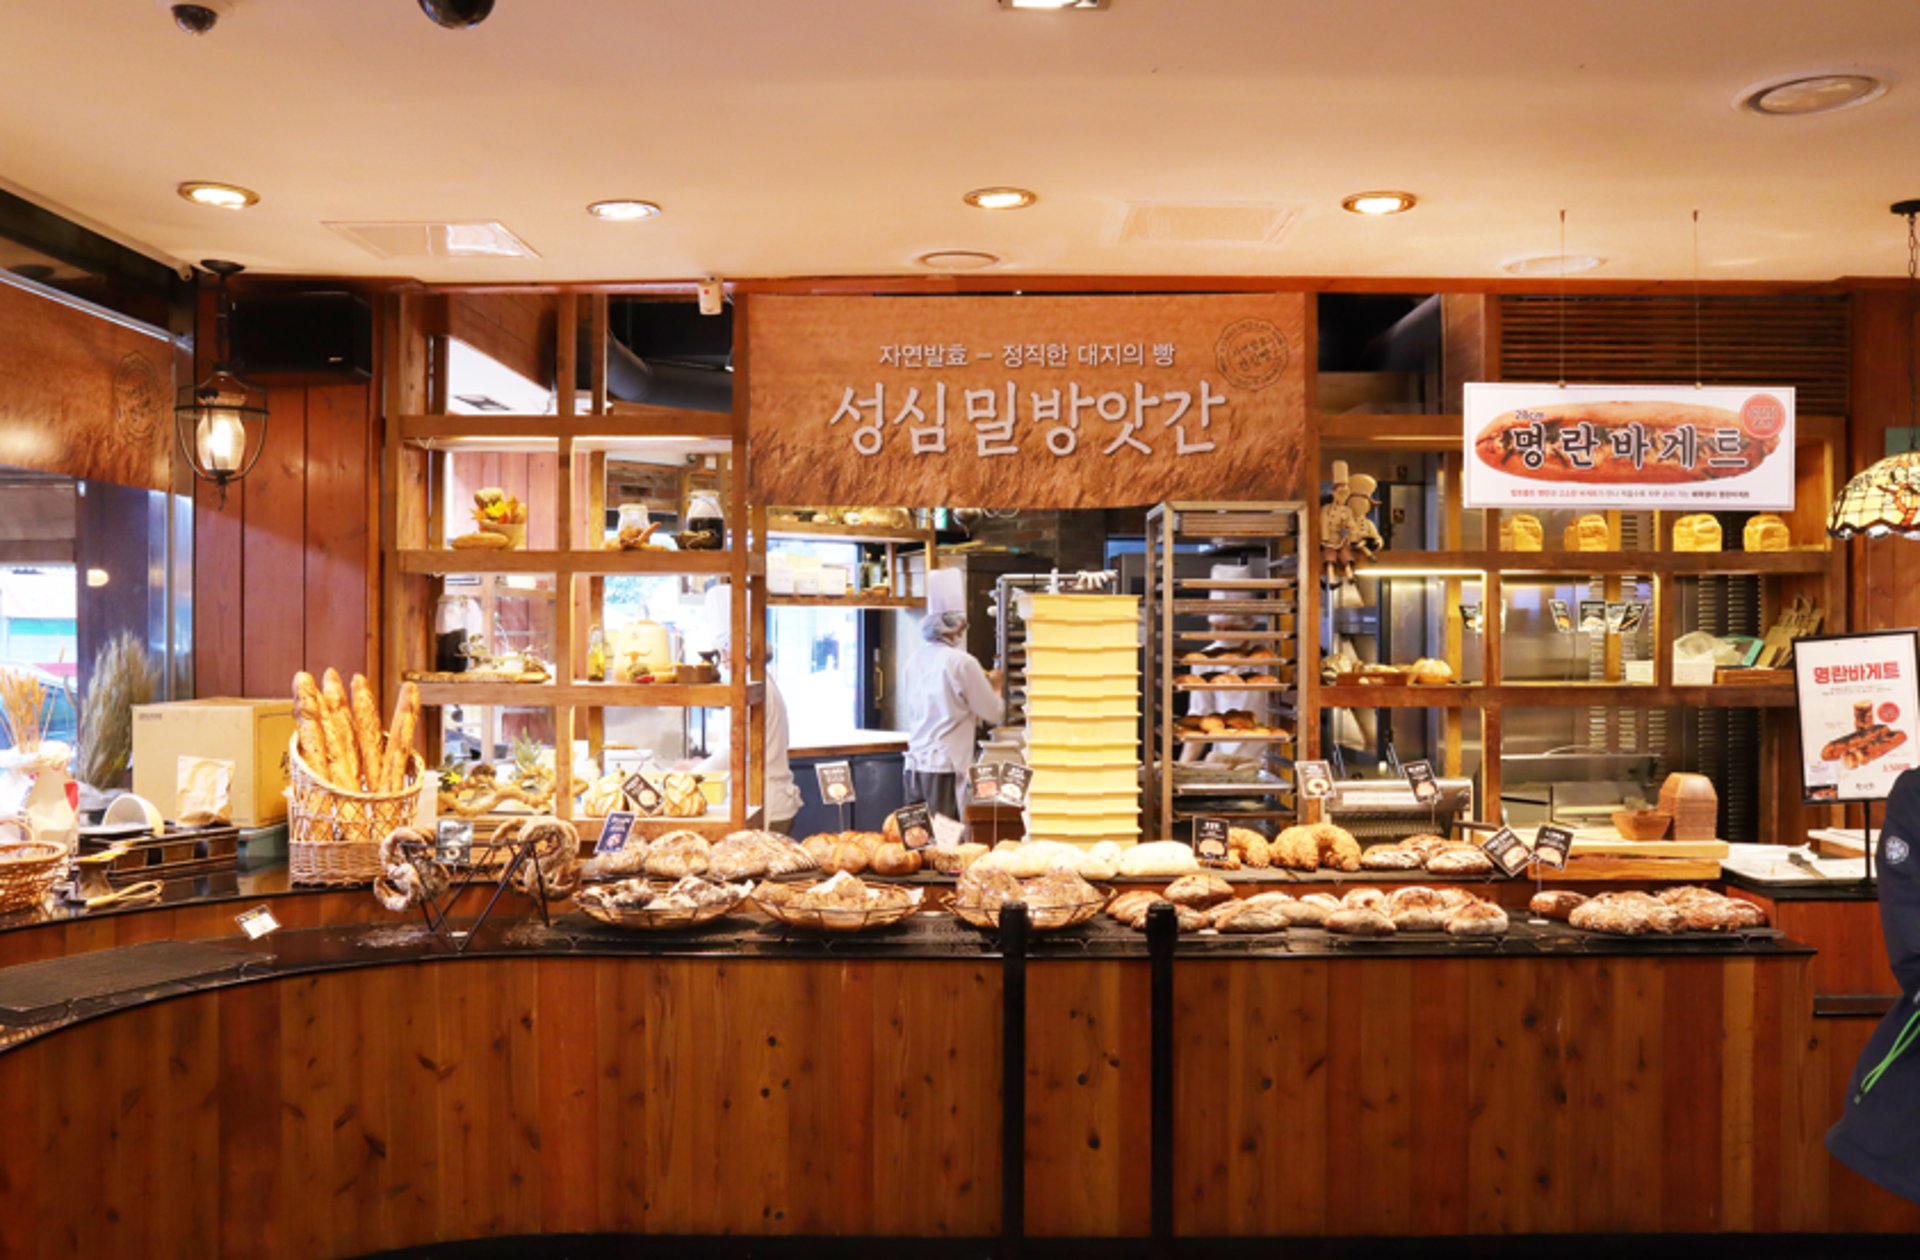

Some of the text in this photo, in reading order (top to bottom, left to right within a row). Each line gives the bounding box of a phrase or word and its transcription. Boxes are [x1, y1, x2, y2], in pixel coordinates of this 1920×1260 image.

[879, 344, 968, 368] 자연발효
[1002, 344, 1068, 367] 정직한
[1077, 343, 1145, 367] 대지의
[1152, 343, 1176, 367] 빵
[1814, 662, 1900, 684] 명란바게트
